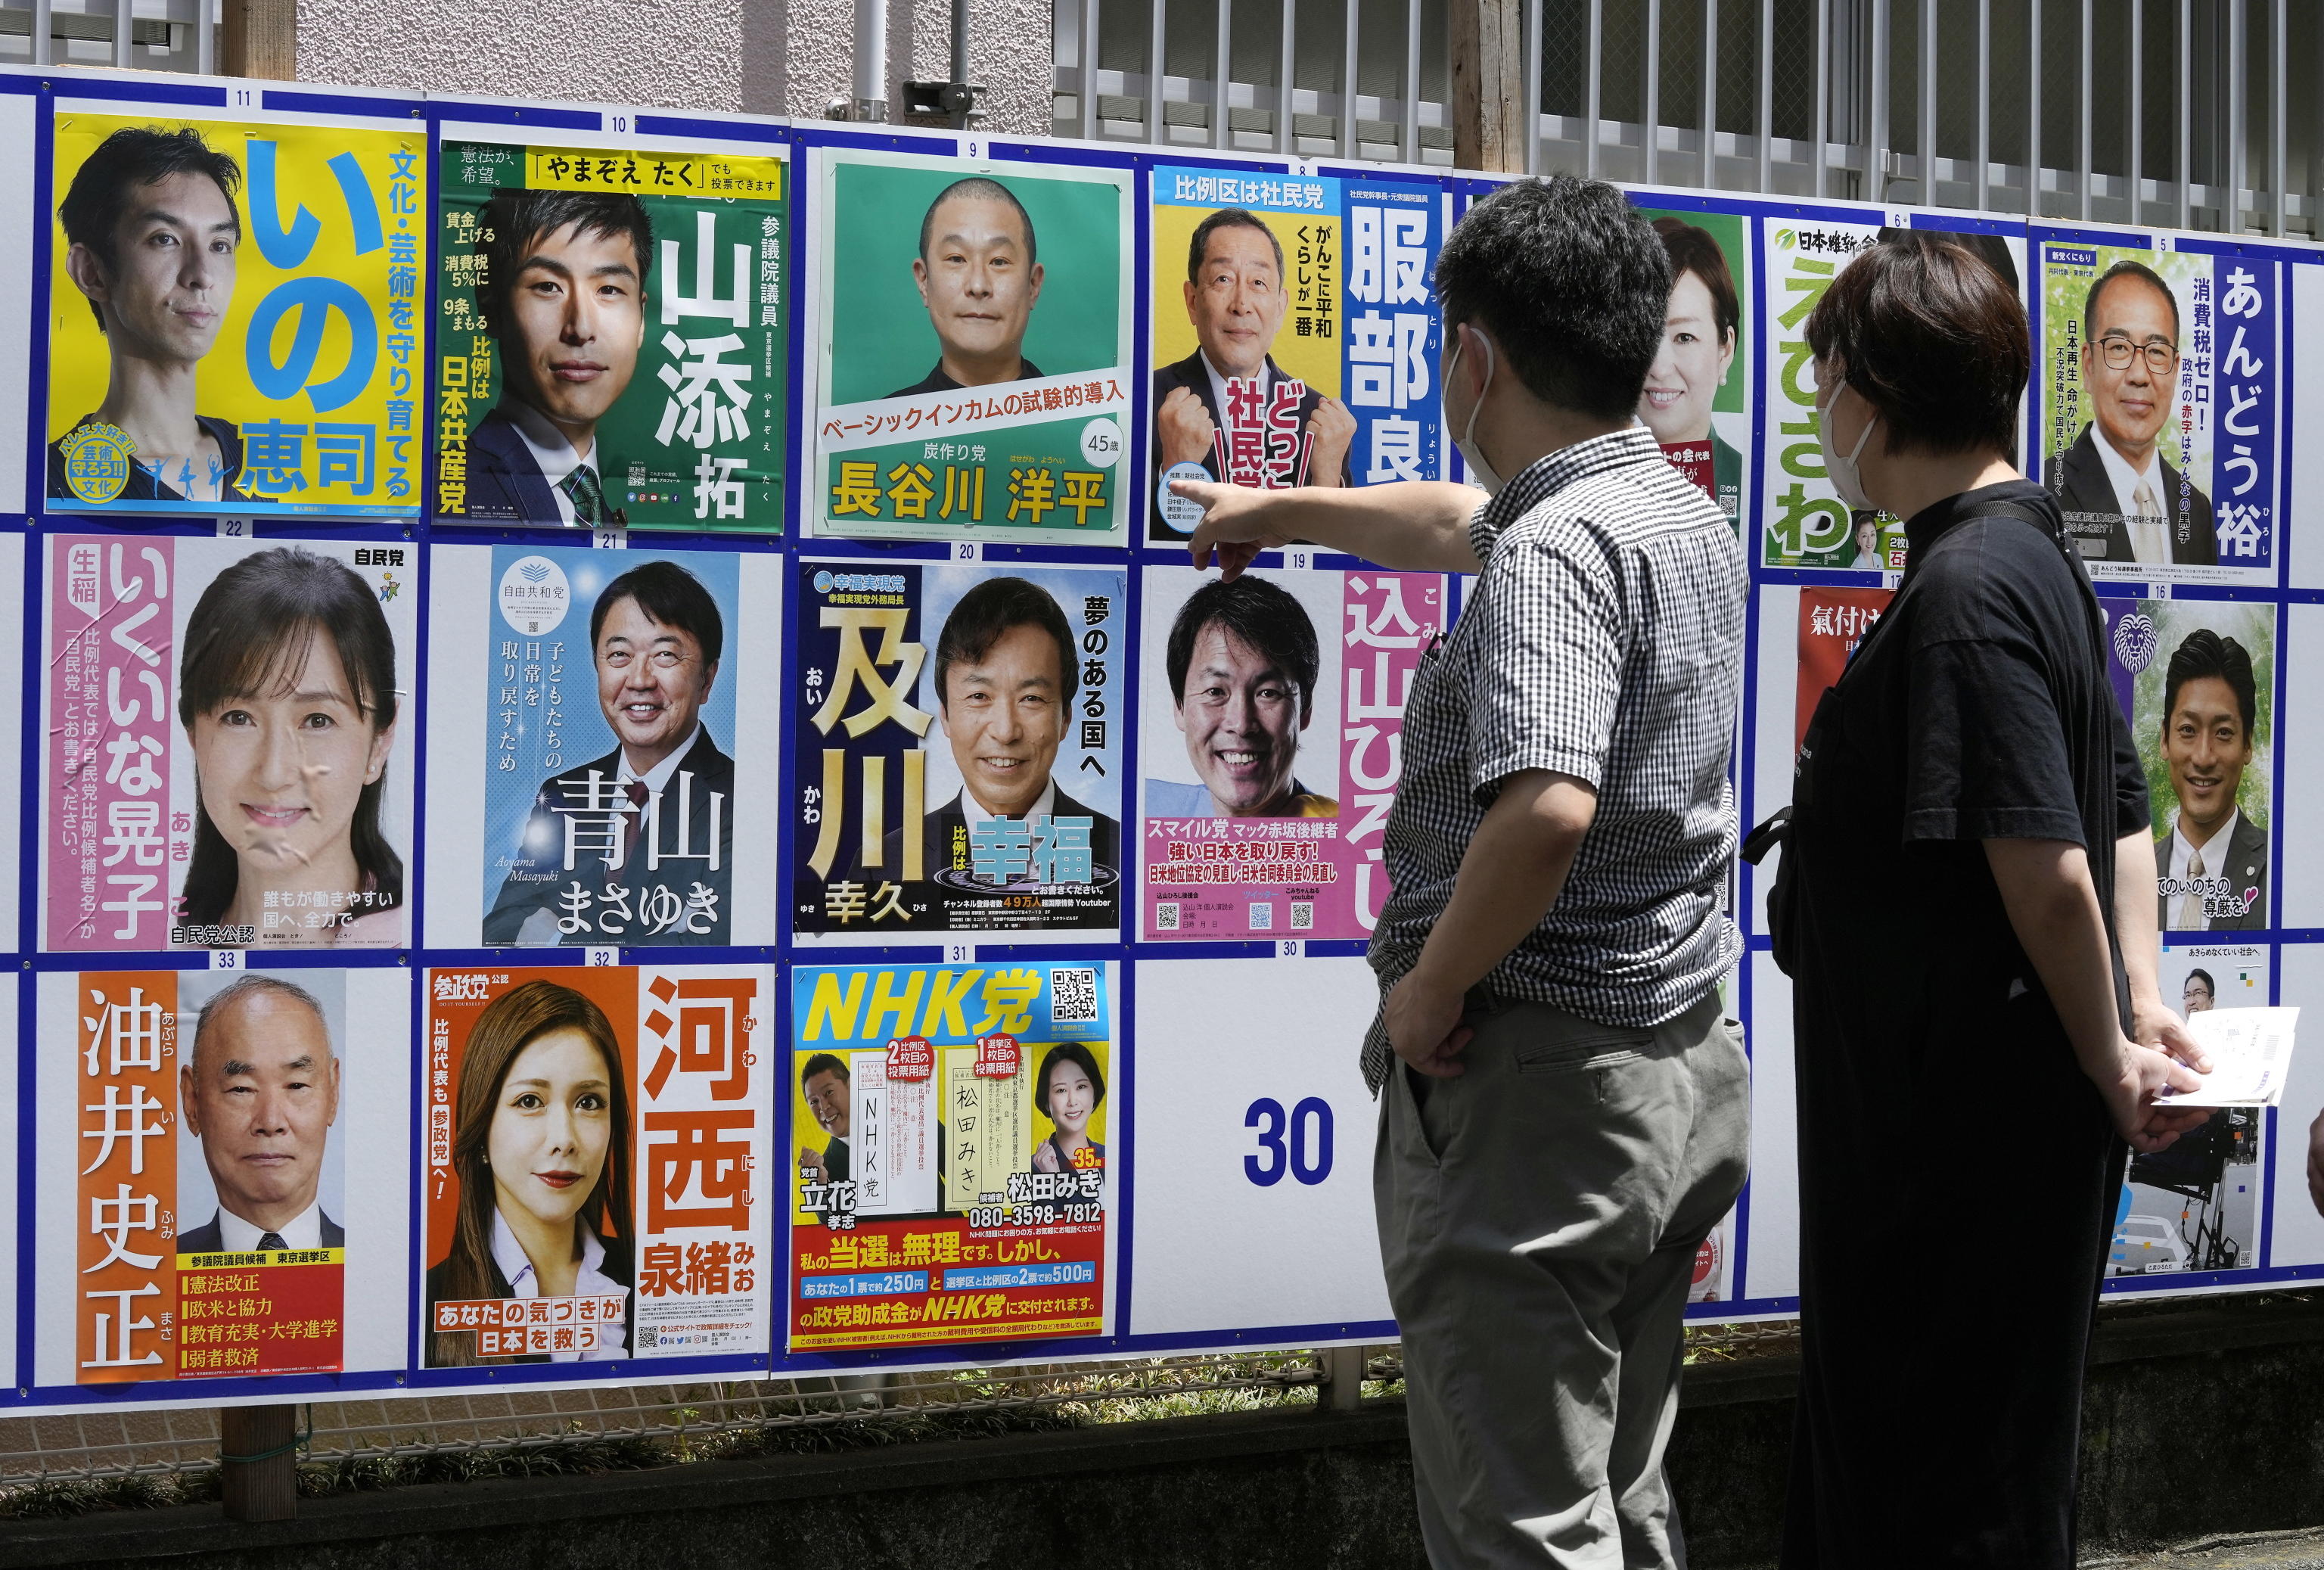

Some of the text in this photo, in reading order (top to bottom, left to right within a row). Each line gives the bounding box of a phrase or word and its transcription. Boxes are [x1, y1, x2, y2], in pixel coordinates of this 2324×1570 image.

[237, 90, 251, 106] 11
[612, 117, 626, 132] 10
[461, 145, 514, 165] 憲法が、
[970, 143, 977, 157] 9
[461, 166, 501, 185] 希望。
[711, 164, 731, 175] でも
[711, 178, 775, 191] 投票できます
[1175, 175, 1324, 209] 比例区は社民党
[446, 212, 475, 228] 賃金
[1894, 214, 1900, 227] 6
[454, 229, 495, 244] 上げる
[2161, 239, 2166, 250] 5
[445, 254, 489, 271] 消費税
[2052, 251, 2091, 263] 新党くにもり
[245, 140, 384, 414] いの
[760, 216, 780, 327] 参議院議員
[1296, 225, 1313, 337] くらしが一番
[1316, 225, 1332, 338] がんこに平和
[443, 297, 470, 315] 9条
[386, 150, 418, 497] 文化・芸術を守り育てる
[452, 316, 488, 331] まもる
[2067, 320, 2078, 381] 日本再生
[471, 335, 491, 399] 比例は
[823, 378, 1125, 439] ベーシックインカムの試験的導入
[763, 393, 772, 451] やまぞえ
[2054, 347, 2065, 496] 不況突破力で国民を守り抜く
[439, 356, 468, 514] 日本共産党
[1088, 434, 1119, 452] 45歳
[238, 420, 376, 496] 恵司
[924, 443, 986, 462] 炭作り党
[1010, 455, 1035, 464] はせがわ
[2178, 358, 2192, 543] 政府の赤字はみんなの黒字
[82, 480, 112, 495] 文化
[832, 462, 1106, 524] 長谷川 洋平
[226, 521, 241, 536] 22
[603, 533, 617, 548] 21
[355, 549, 404, 567] 自民党
[960, 544, 974, 560] 20
[1293, 554, 1305, 567] 19
[72, 550, 96, 603] 生稲
[834, 575, 905, 592] 幸福実現党
[505, 584, 564, 599] 自由共和党
[828, 593, 904, 605] 幸福実現党外務局長
[2156, 586, 2165, 598] 16
[524, 642, 542, 707] 日常を
[1080, 595, 1110, 778] 夢のある国へ
[499, 640, 519, 772] 取り戻すため
[545, 641, 564, 769] 子どもたちの
[102, 543, 167, 940] いくいな晃子
[803, 667, 822, 824] おい かわ
[808, 606, 934, 883] 及川
[551, 769, 725, 871] 青山
[1148, 819, 1338, 839] スマイル党 マック赤坂後継者
[952, 825, 966, 871] 比例は
[971, 815, 1093, 884] 幸福
[495, 856, 535, 871] Aoyama
[510, 869, 558, 884] Masayuki
[263, 891, 393, 907] 誰もが働きやすい
[825, 881, 912, 924] 幸久
[1076, 898, 1111, 907] Youtuber
[1243, 891, 1279, 900] ツイッター
[557, 881, 719, 936] まさゆき
[263, 911, 360, 928] 国へ、全力で。
[171, 926, 255, 944] 自民党公認
[953, 947, 966, 961] 31
[1284, 941, 1297, 956] 30
[2189, 947, 2260, 957] あきらめなくていい社会へ。
[219, 953, 235, 968] 33
[595, 952, 609, 966] 32
[434, 975, 508, 1000] 参政党 公認
[803, 968, 1042, 1041] NHK党
[162, 1012, 175, 1056] あぶら
[987, 1039, 1012, 1048] 選挙区
[900, 1042, 926, 1051] 比例区
[987, 1049, 1015, 1061] 枚目の
[900, 1052, 929, 1064] 枚目の
[976, 1062, 1016, 1074] 投票用紙
[888, 1065, 930, 1077] 投票用紙
[644, 975, 757, 1235] 河西
[741, 1015, 757, 1207] かわ にし
[863, 1098, 879, 1198] NHK党
[956, 1085, 979, 1191] 松田みき
[1244, 1096, 1334, 1187] 30
[82, 987, 165, 1368] 油井史正
[801, 1167, 817, 1178] 党首
[800, 1180, 856, 1212] 立花
[1008, 1171, 1101, 1203] 松田みき
[979, 1192, 1004, 1204] 候補者
[160, 1211, 174, 1239] ふみ
[828, 1214, 856, 1230] 孝志
[969, 1205, 1101, 1229] 080-3598-7812
[191, 1252, 330, 1267] 参議院議員候補 東京選挙区
[639, 1241, 731, 1297] 泉緒
[733, 1242, 755, 1292] みお
[189, 1274, 259, 1295] 憲法改正
[931, 1278, 941, 1291] と
[189, 1298, 272, 1319] 欧米と協力
[440, 1297, 622, 1326] あなたの気づきが
[160, 1311, 173, 1340] まさ
[189, 1319, 337, 1345] 教育充実・大学進学
[481, 1326, 595, 1353] 日本を救う
[188, 1347, 259, 1368] 弱者救済
